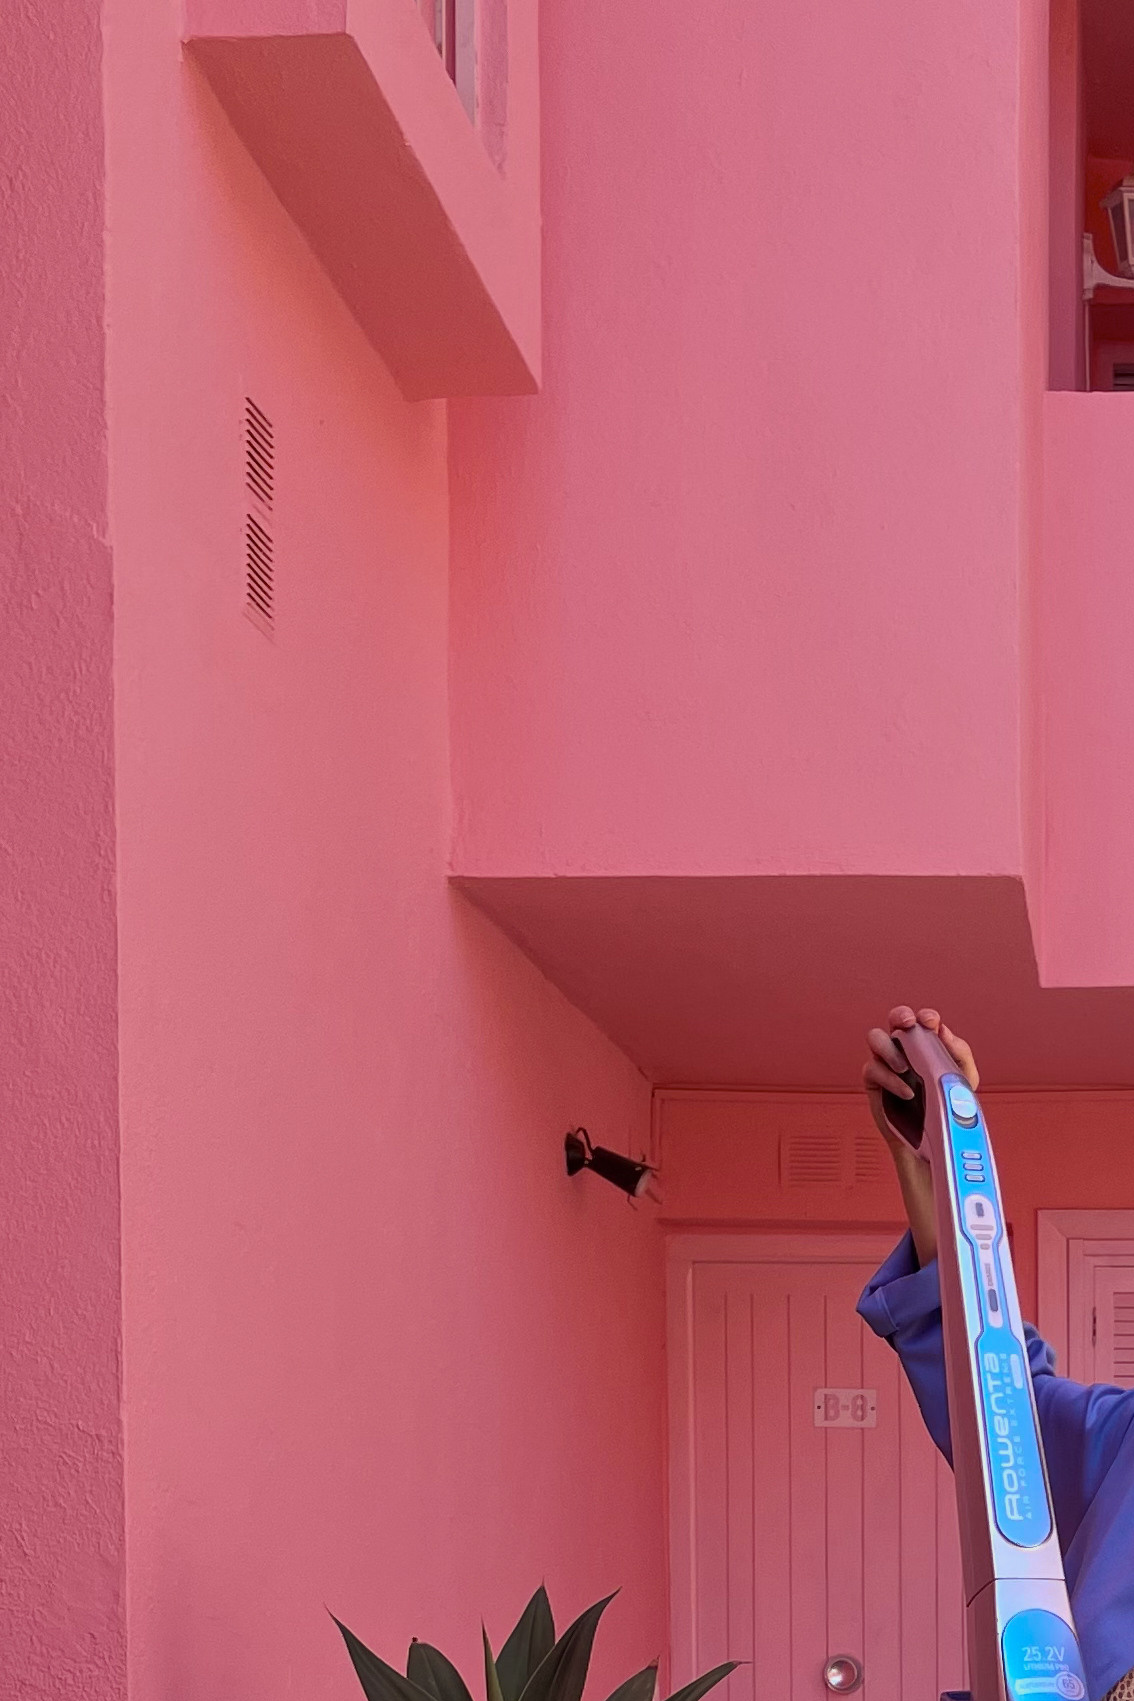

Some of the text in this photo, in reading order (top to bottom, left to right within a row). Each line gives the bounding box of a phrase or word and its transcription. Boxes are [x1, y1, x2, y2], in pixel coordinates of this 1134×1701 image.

[1000, 1353, 1033, 1520] AIR FORCE EXTREME
